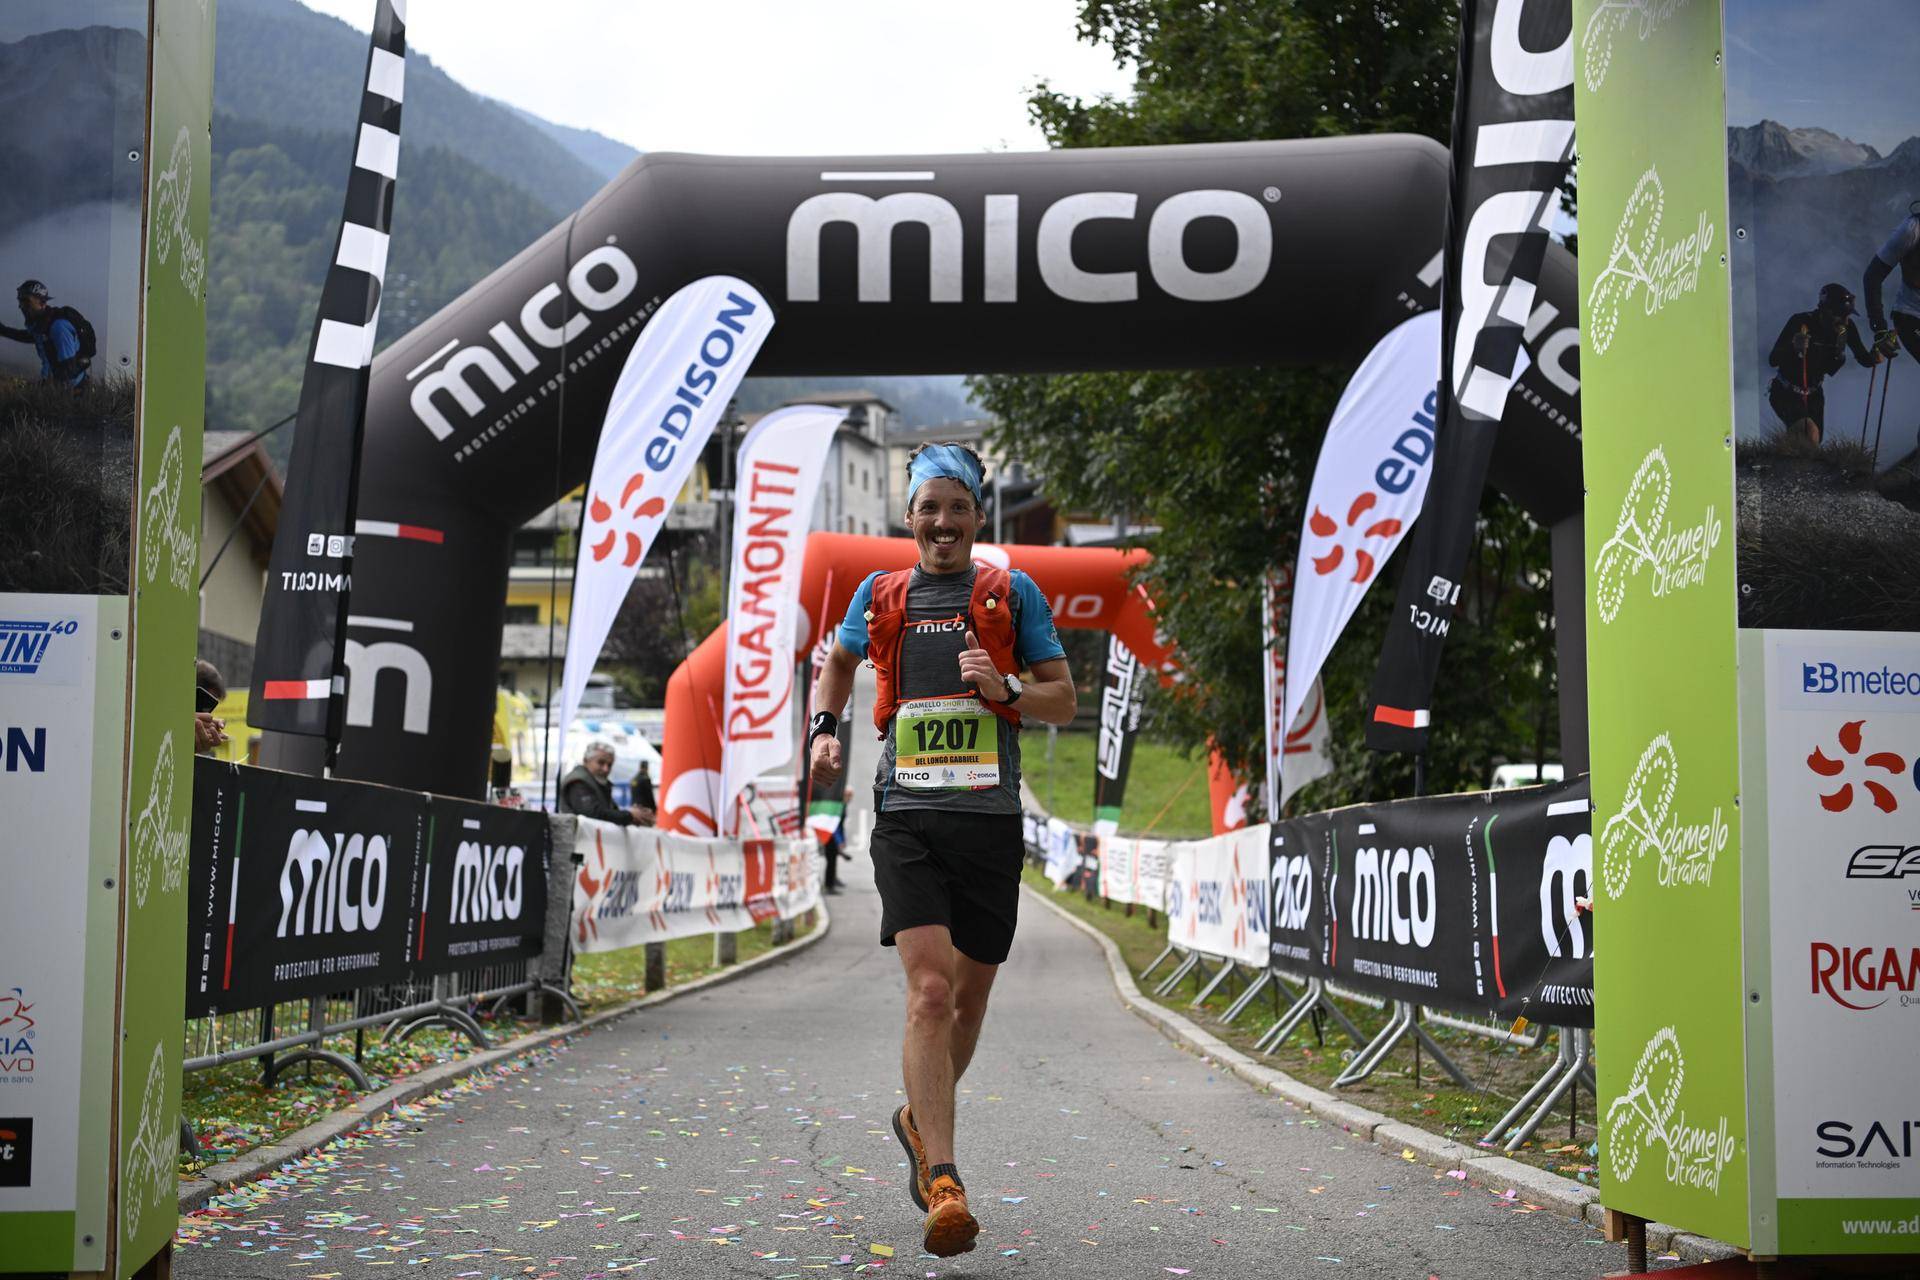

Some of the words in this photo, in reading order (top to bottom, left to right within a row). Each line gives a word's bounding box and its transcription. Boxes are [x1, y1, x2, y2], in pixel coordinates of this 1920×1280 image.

[728, 460, 800, 743] RIGAMONTI
[50, 620, 78, 635] 40
[912, 718, 980, 752] 1207
[915, 756, 926, 765] DEL
[274, 961, 320, 981] PROTECTION
[322, 958, 335, 974] FOR
[337, 952, 381, 970] PERFORMANCE
[1394, 967, 1439, 989] PERFORMANCE
[1816, 1161, 1856, 1169] Information
[1857, 1161, 1901, 1170] Technologies
